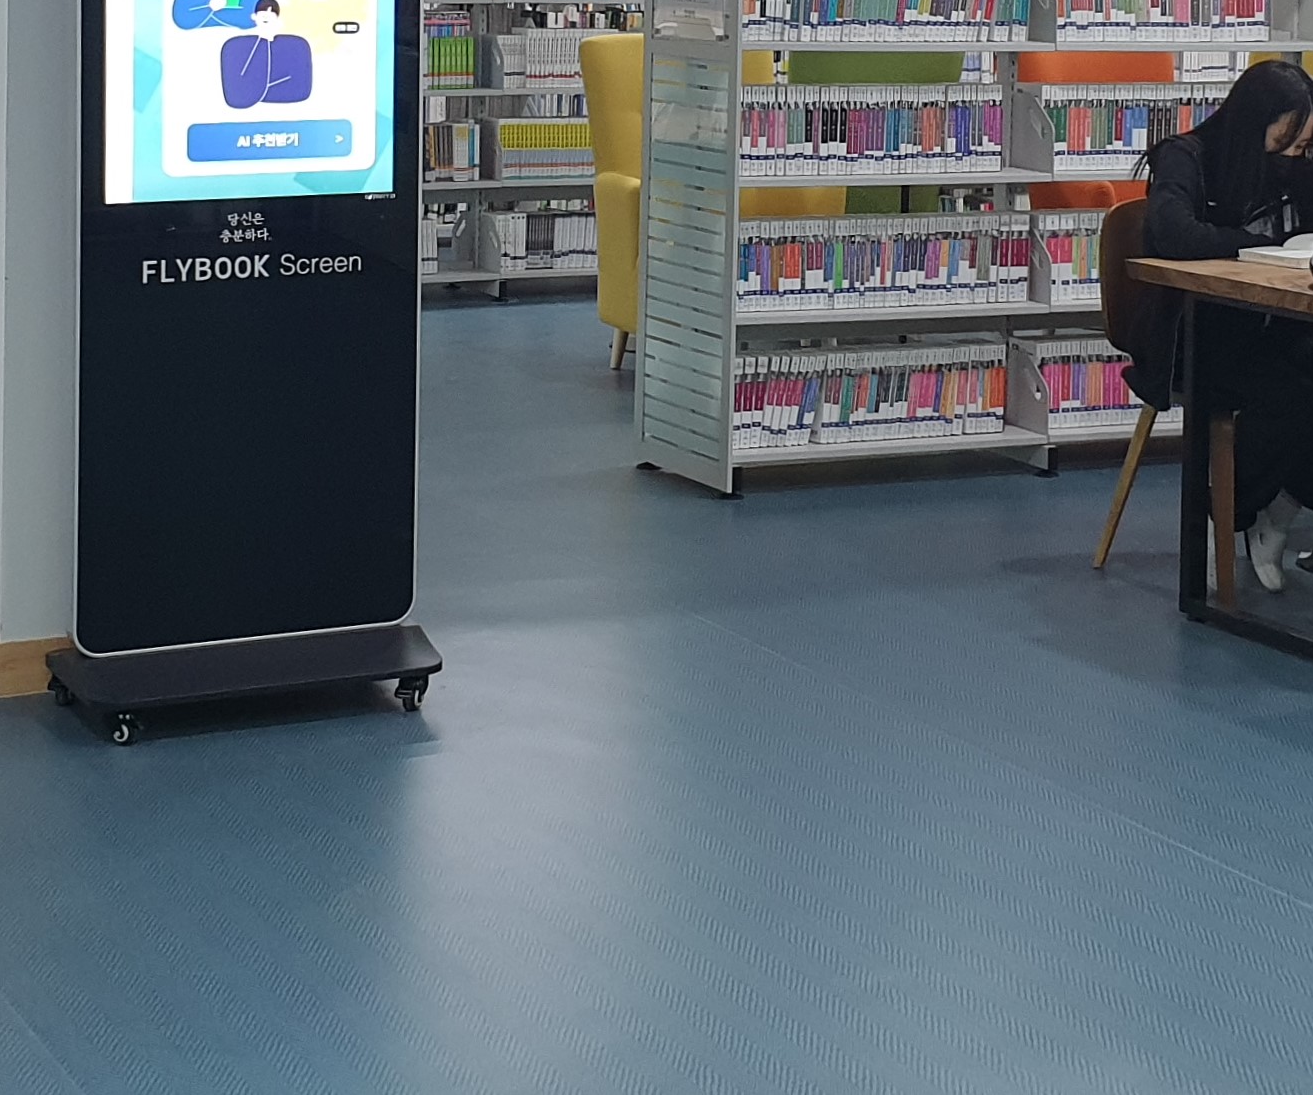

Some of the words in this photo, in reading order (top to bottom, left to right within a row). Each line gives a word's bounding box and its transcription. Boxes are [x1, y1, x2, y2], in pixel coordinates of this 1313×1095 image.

[236, 135, 251, 147] AI
[227, 211, 265, 227] 당신은
[142, 254, 271, 285] FLYBOOK
[279, 253, 362, 276] Screen
